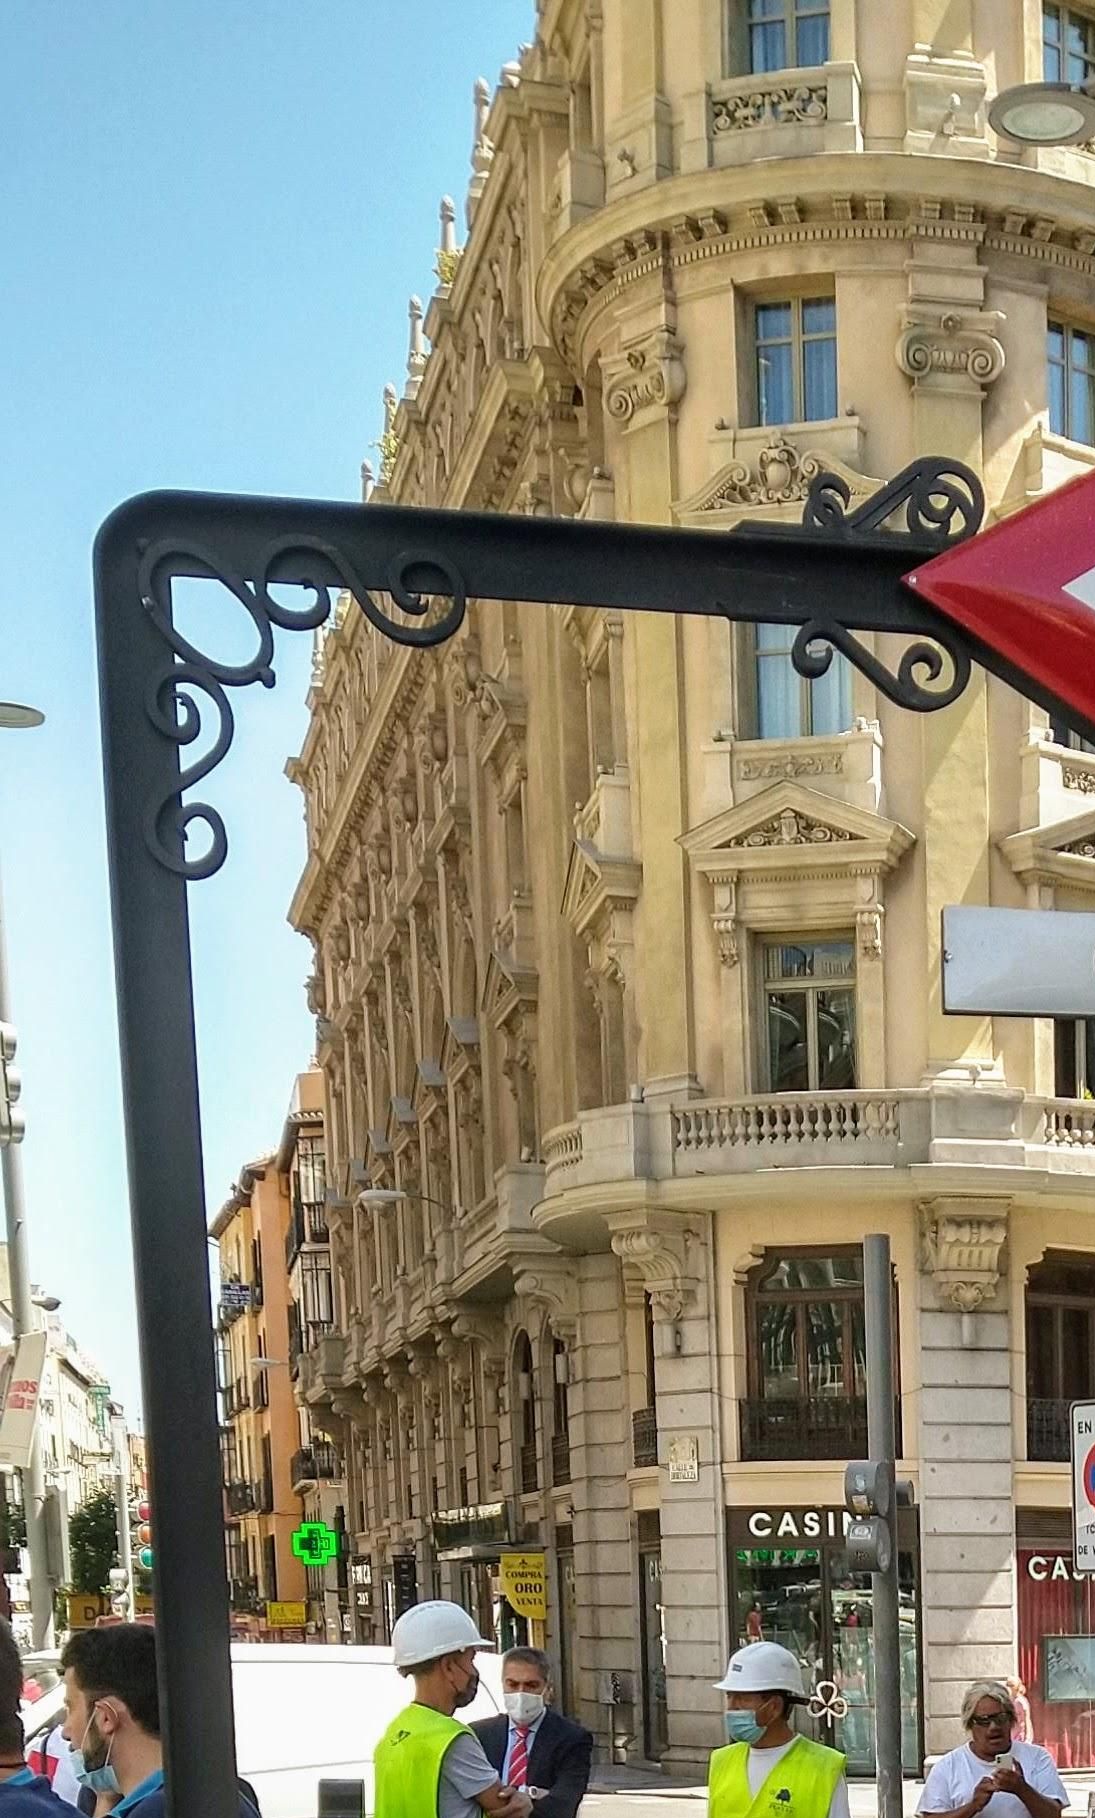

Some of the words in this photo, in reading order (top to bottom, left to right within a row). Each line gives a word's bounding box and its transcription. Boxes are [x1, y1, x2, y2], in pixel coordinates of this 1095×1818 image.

[1077, 1420, 1093, 1435] EN
[748, 1511, 863, 1537] CASI
[1077, 1545, 1089, 1556] DE
[505, 1570, 543, 1580] COMPRA
[514, 1582, 543, 1595] ORO
[515, 1597, 544, 1607] VENTA
